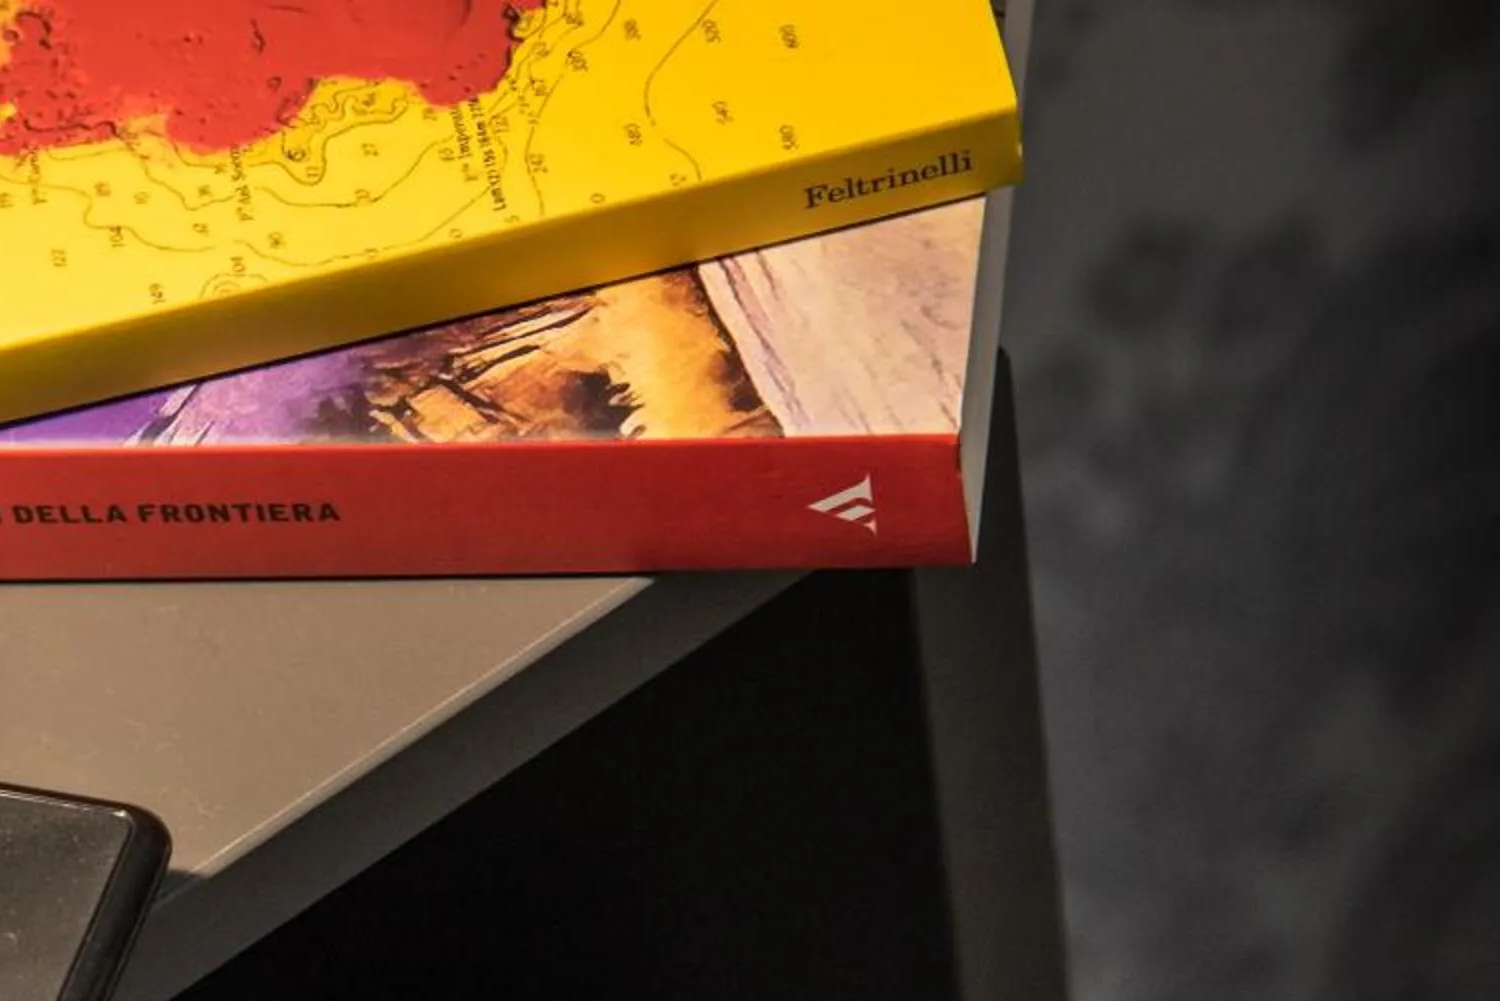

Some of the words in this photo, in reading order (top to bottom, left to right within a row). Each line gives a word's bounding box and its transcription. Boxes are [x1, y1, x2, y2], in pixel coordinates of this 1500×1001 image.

[804, 148, 974, 210] Feltrinelli
[12, 503, 127, 525] DELLA
[136, 502, 342, 523] FRONTIERA
